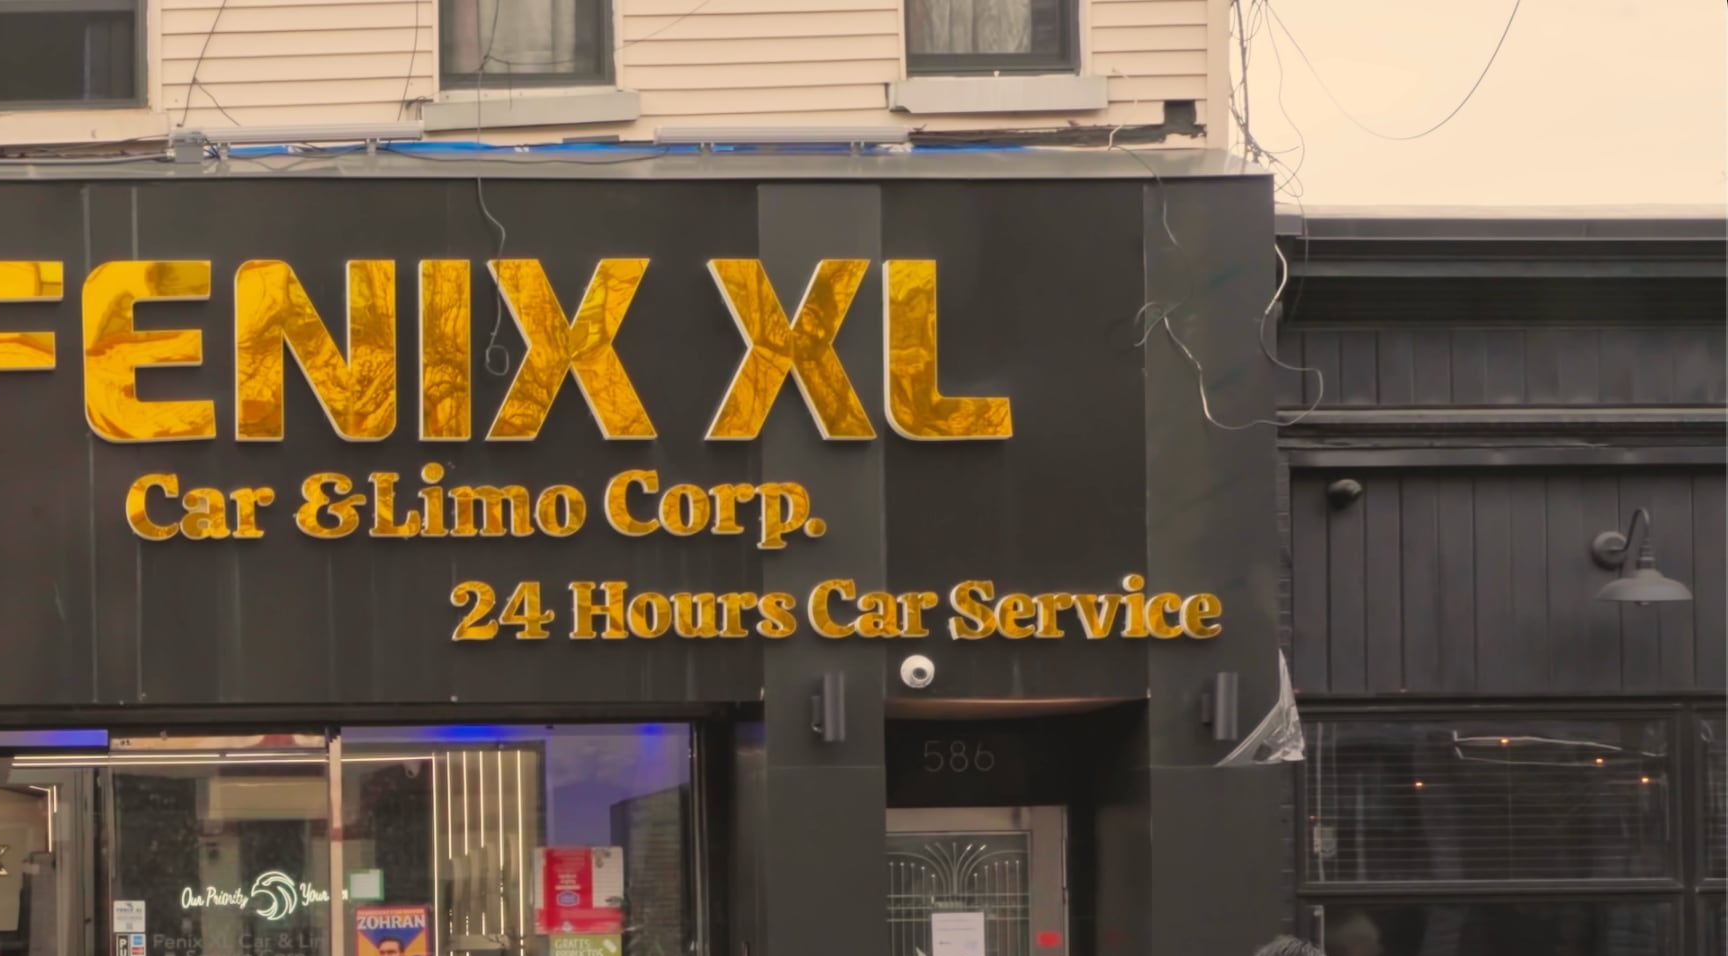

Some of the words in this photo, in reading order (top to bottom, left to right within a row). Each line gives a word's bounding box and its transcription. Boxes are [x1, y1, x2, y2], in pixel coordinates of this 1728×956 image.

[703, 258, 1014, 442] XL
[124, 473, 275, 542] Car
[603, 468, 828, 551] Corp.
[449, 580, 556, 641] 24
[567, 580, 798, 641] Hours
[808, 577, 939, 640] Car
[948, 574, 1224, 641] Service
[923, 740, 995, 773] 586
[181, 886, 205, 910] Our
[206, 885, 249, 910] Priority
[358, 914, 426, 930] ZOHRAN
[238, 934, 272, 949] Car
[277, 934, 294, 949] &
